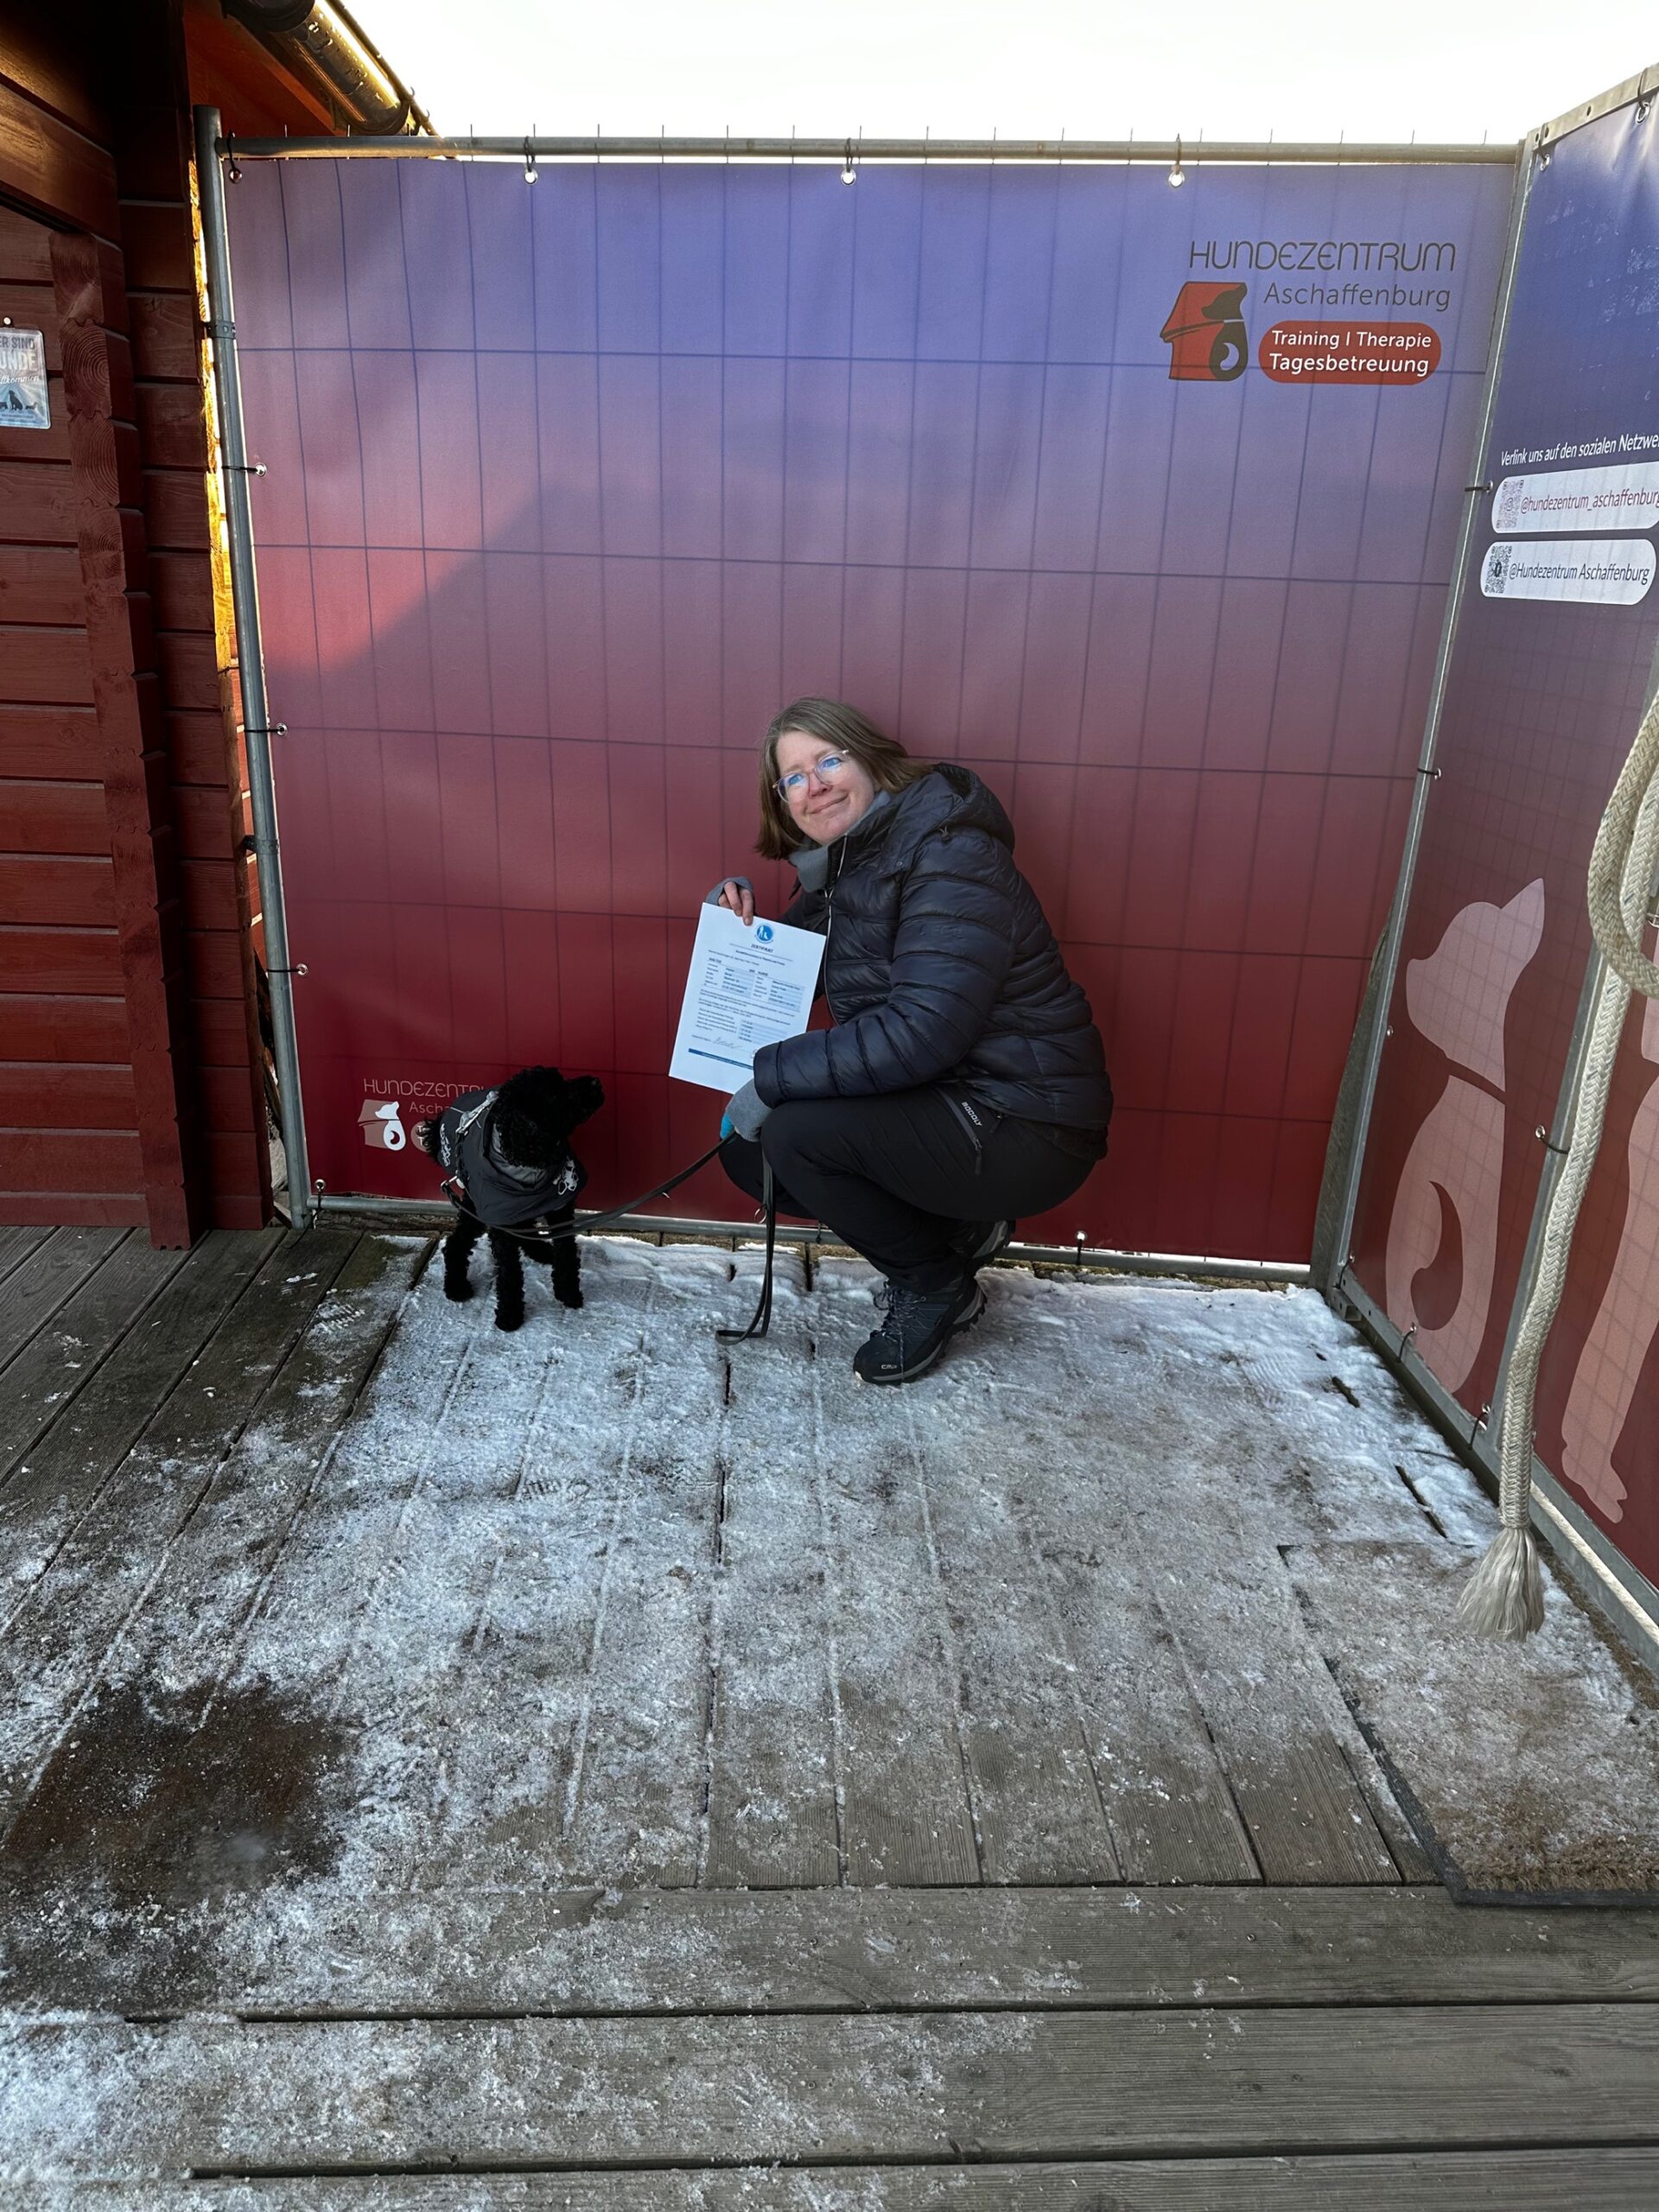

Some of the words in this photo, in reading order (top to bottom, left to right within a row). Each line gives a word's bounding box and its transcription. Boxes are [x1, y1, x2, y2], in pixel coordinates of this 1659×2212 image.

[1189, 240, 1456, 271] HUNDEZENTRUM
[1263, 282, 1452, 312] Aschaffenburg
[1271, 329, 1340, 349] Training
[1356, 331, 1432, 350] Therapie
[1268, 353, 1430, 378] Tagesbetreuung
[1501, 448, 1527, 467] Verlink
[1529, 450, 1543, 463] uns
[1544, 443, 1561, 461] auf
[1560, 442, 1577, 459] den
[1578, 436, 1617, 457] sozialen
[1618, 433, 1659, 453] Netzwe
[1509, 563, 1578, 580] @Hundezentrum
[1578, 563, 1649, 586] Aschaffenburg
